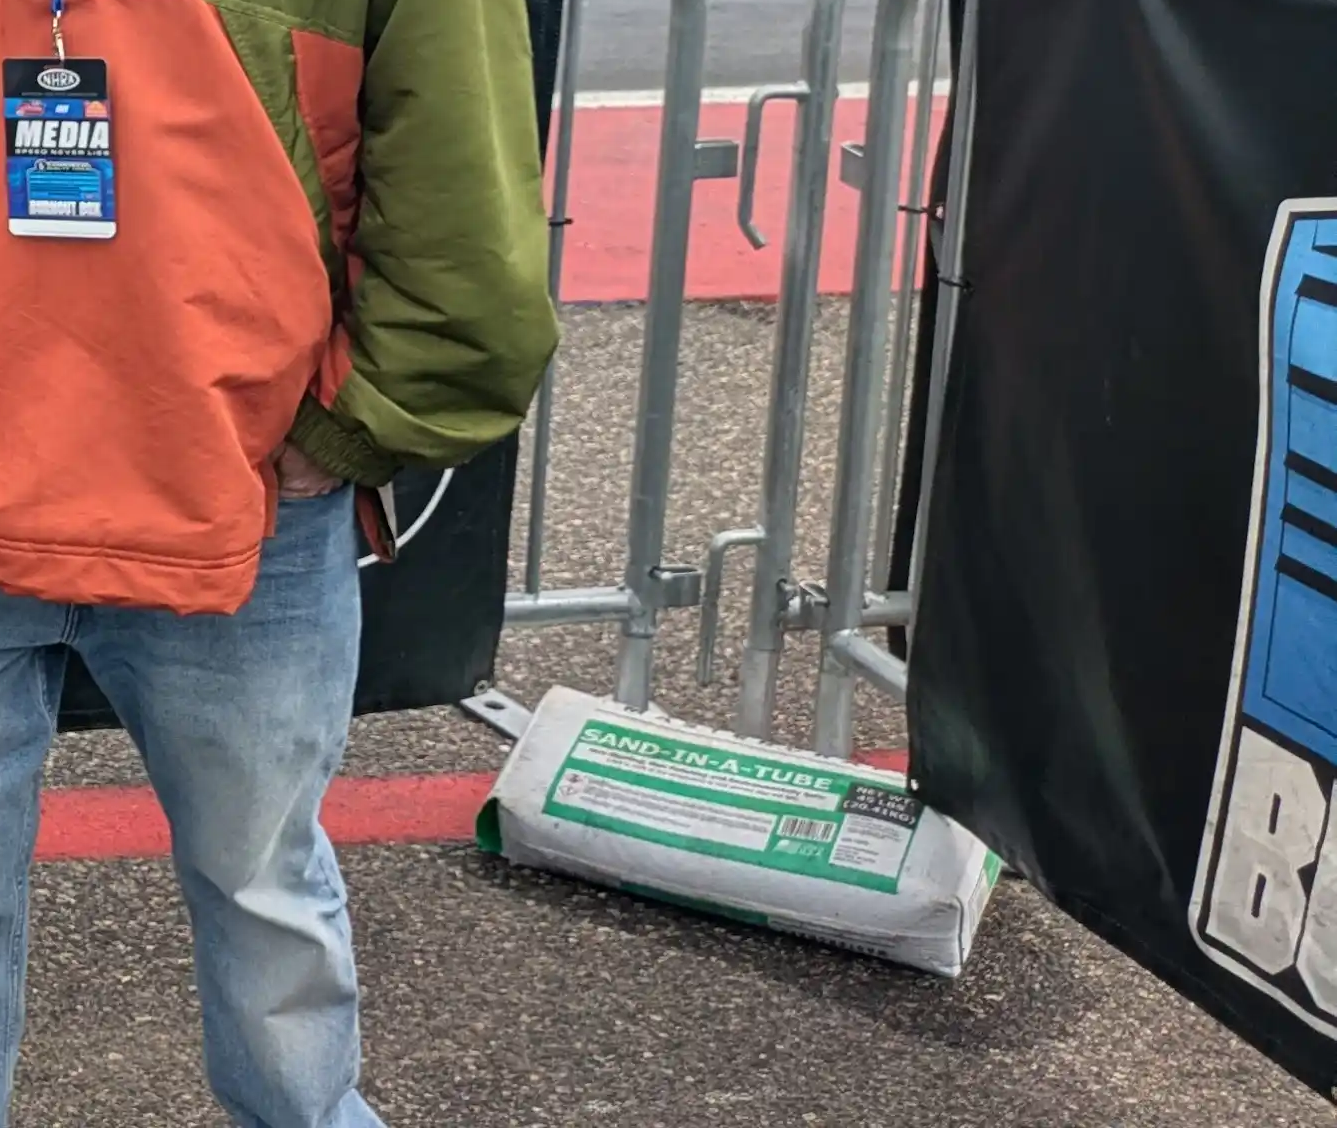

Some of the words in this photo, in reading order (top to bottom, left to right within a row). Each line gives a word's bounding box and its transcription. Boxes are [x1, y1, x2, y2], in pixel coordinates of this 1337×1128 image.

[43, 74, 75, 87] NHRA
[15, 119, 110, 150] MEDIA
[15, 147, 48, 156] SPEED
[51, 147, 85, 156] NEVER
[87, 149, 111, 157] LIES
[580, 728, 834, 792] SAND-IN-A-TUBE
